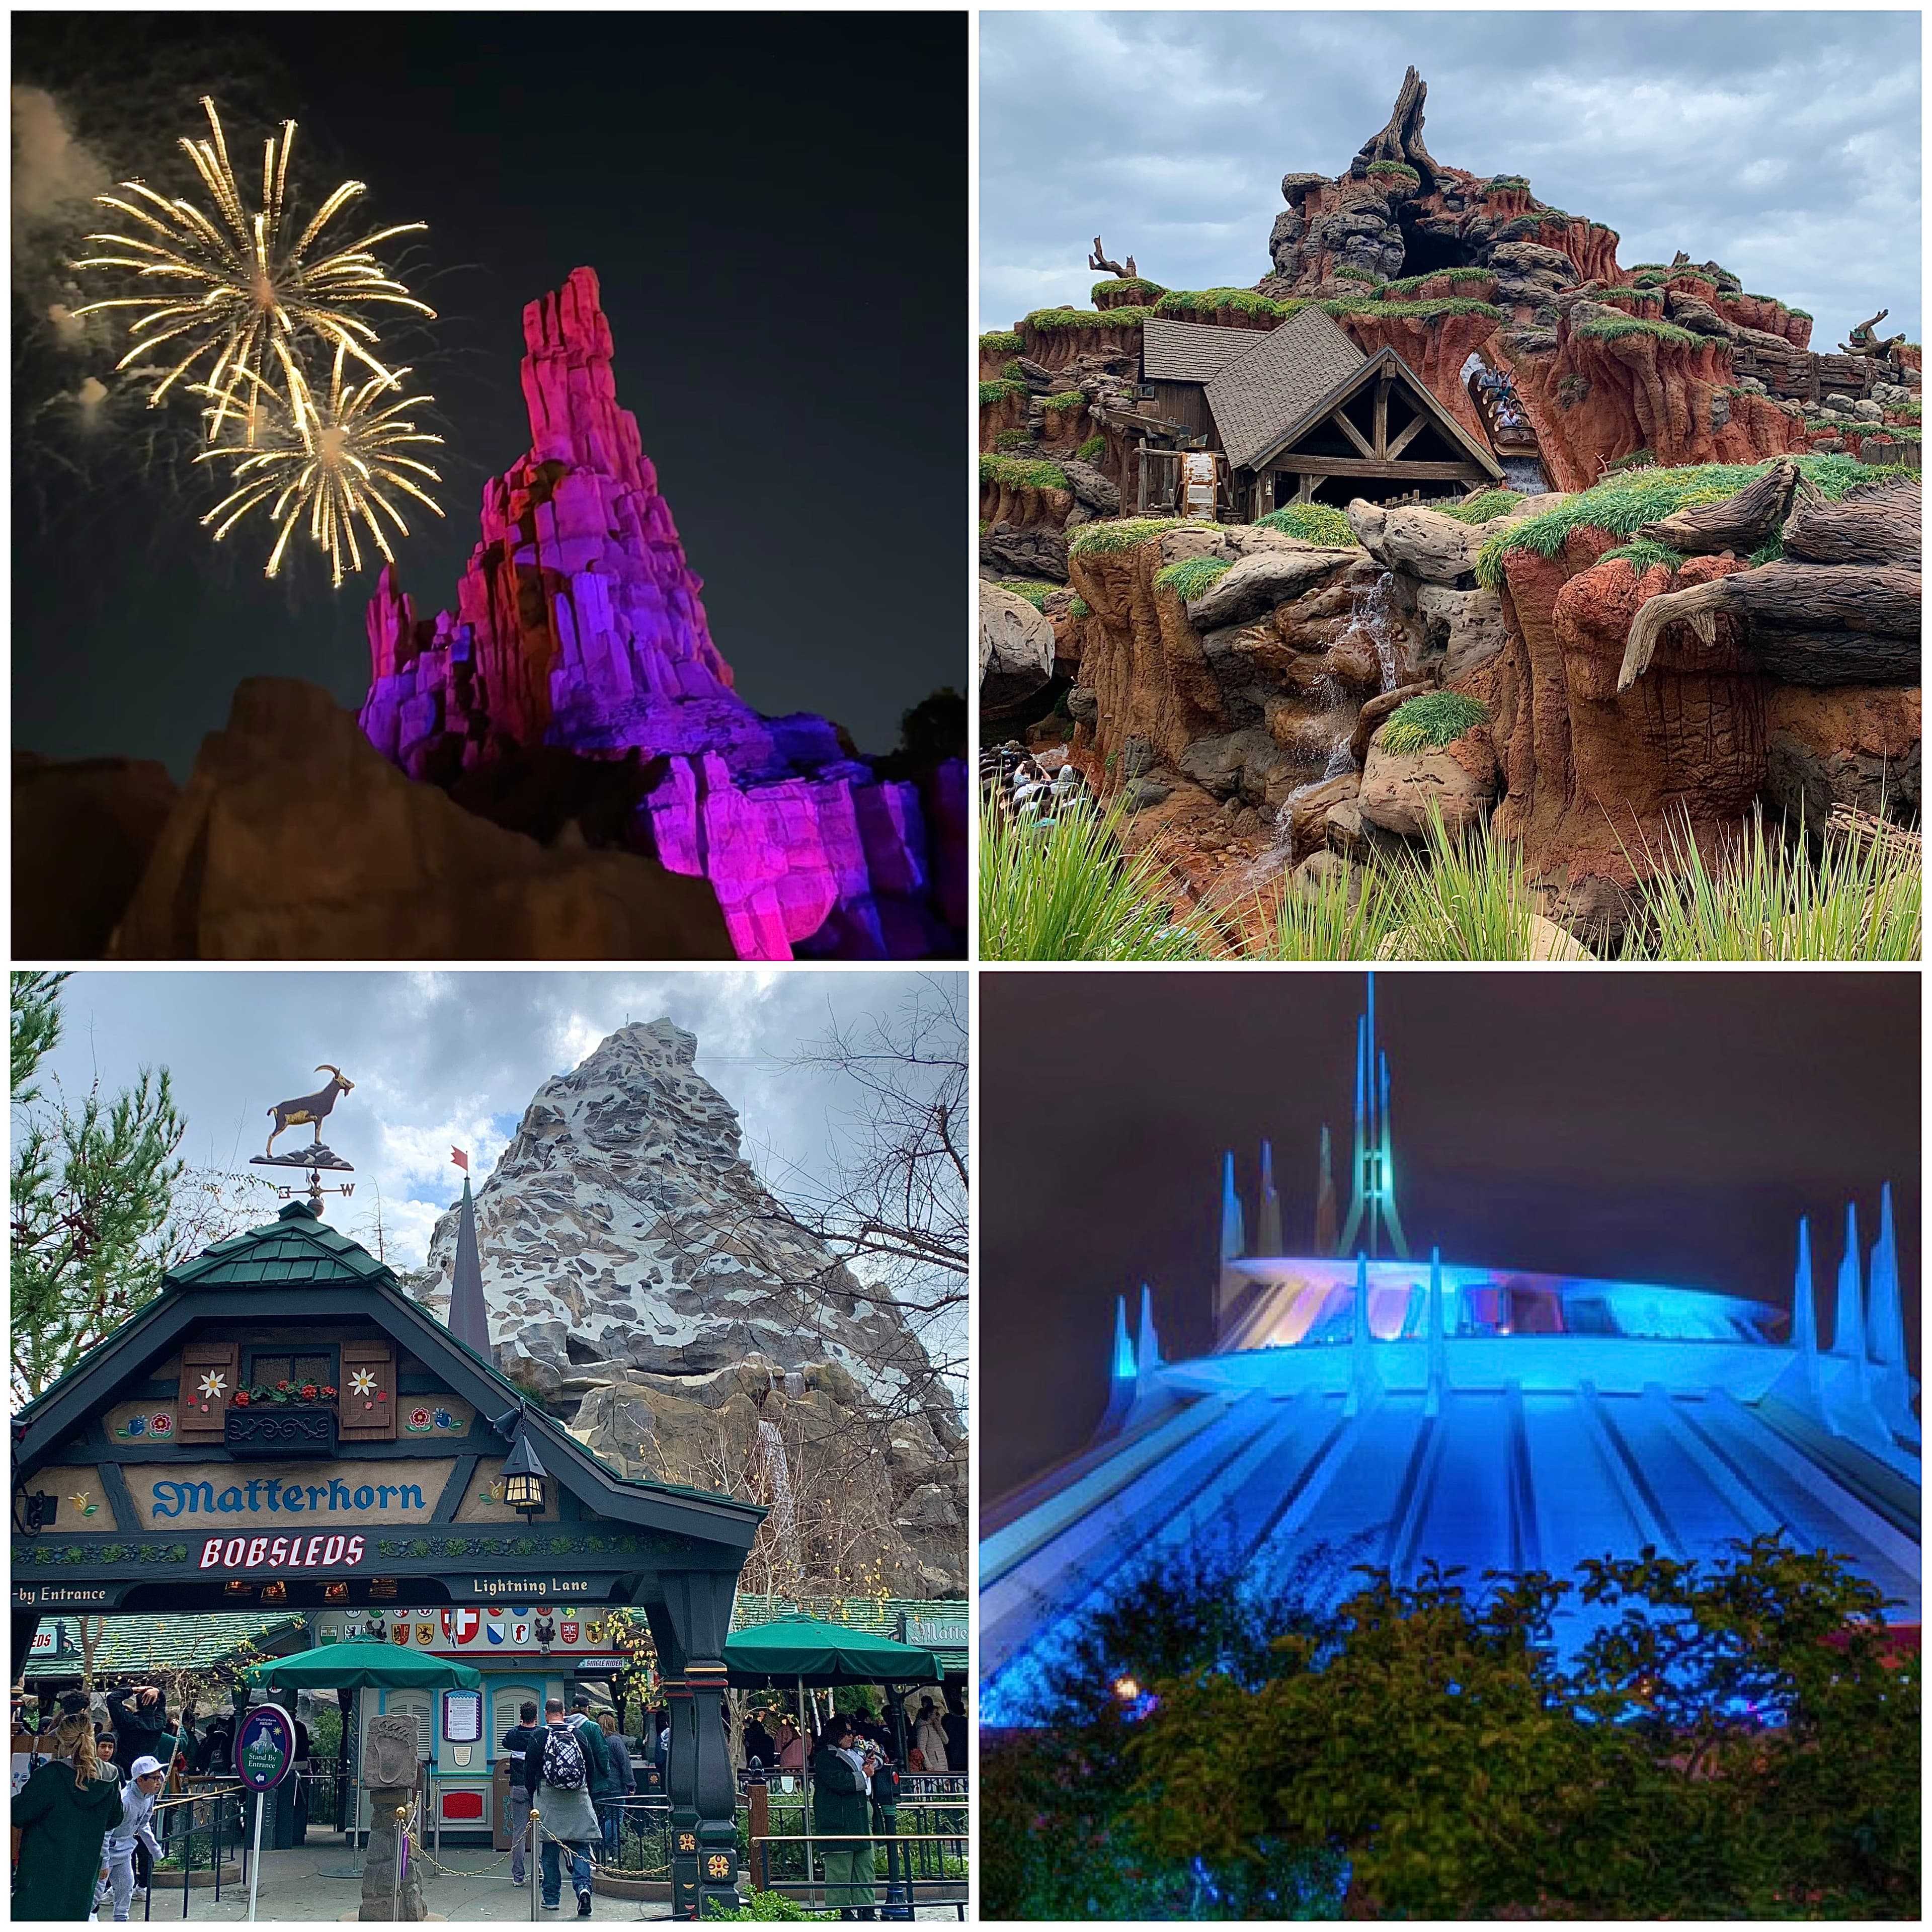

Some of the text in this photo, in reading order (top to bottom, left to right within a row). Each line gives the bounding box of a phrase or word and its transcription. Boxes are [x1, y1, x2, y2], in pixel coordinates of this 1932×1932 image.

[340, 1183, 355, 1197] W
[152, 1478, 427, 1518] Matterhorn
[199, 1534, 365, 1568] BOBSLEDS
[41, 1587, 106, 1600] Entrance
[473, 1578, 588, 1596] Lightning Lane
[249, 1752, 276, 1762] Stand By
[248, 1760, 276, 1769] Entrance
